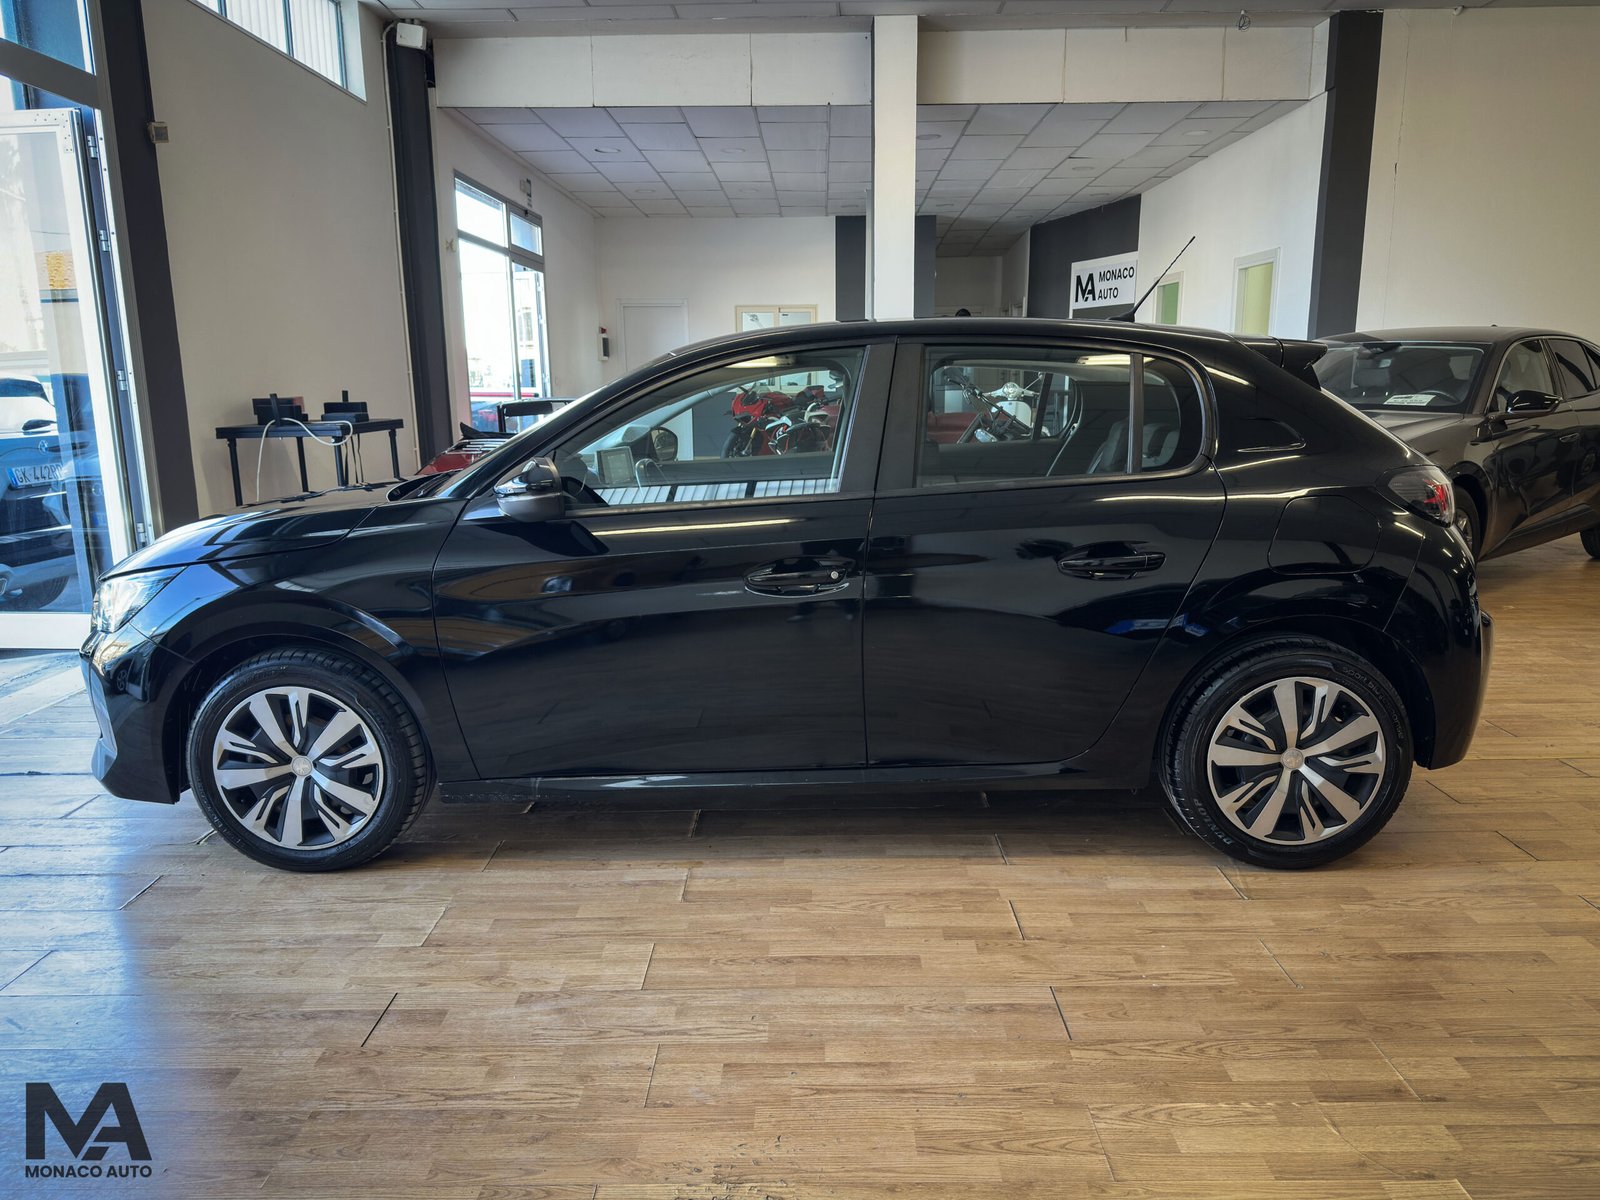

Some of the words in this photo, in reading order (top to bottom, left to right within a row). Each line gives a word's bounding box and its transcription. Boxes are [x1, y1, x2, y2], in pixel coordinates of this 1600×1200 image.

[1098, 266, 1135, 283] MONACO
[1097, 287, 1119, 301] AUTO
[15, 468, 31, 484] GK
